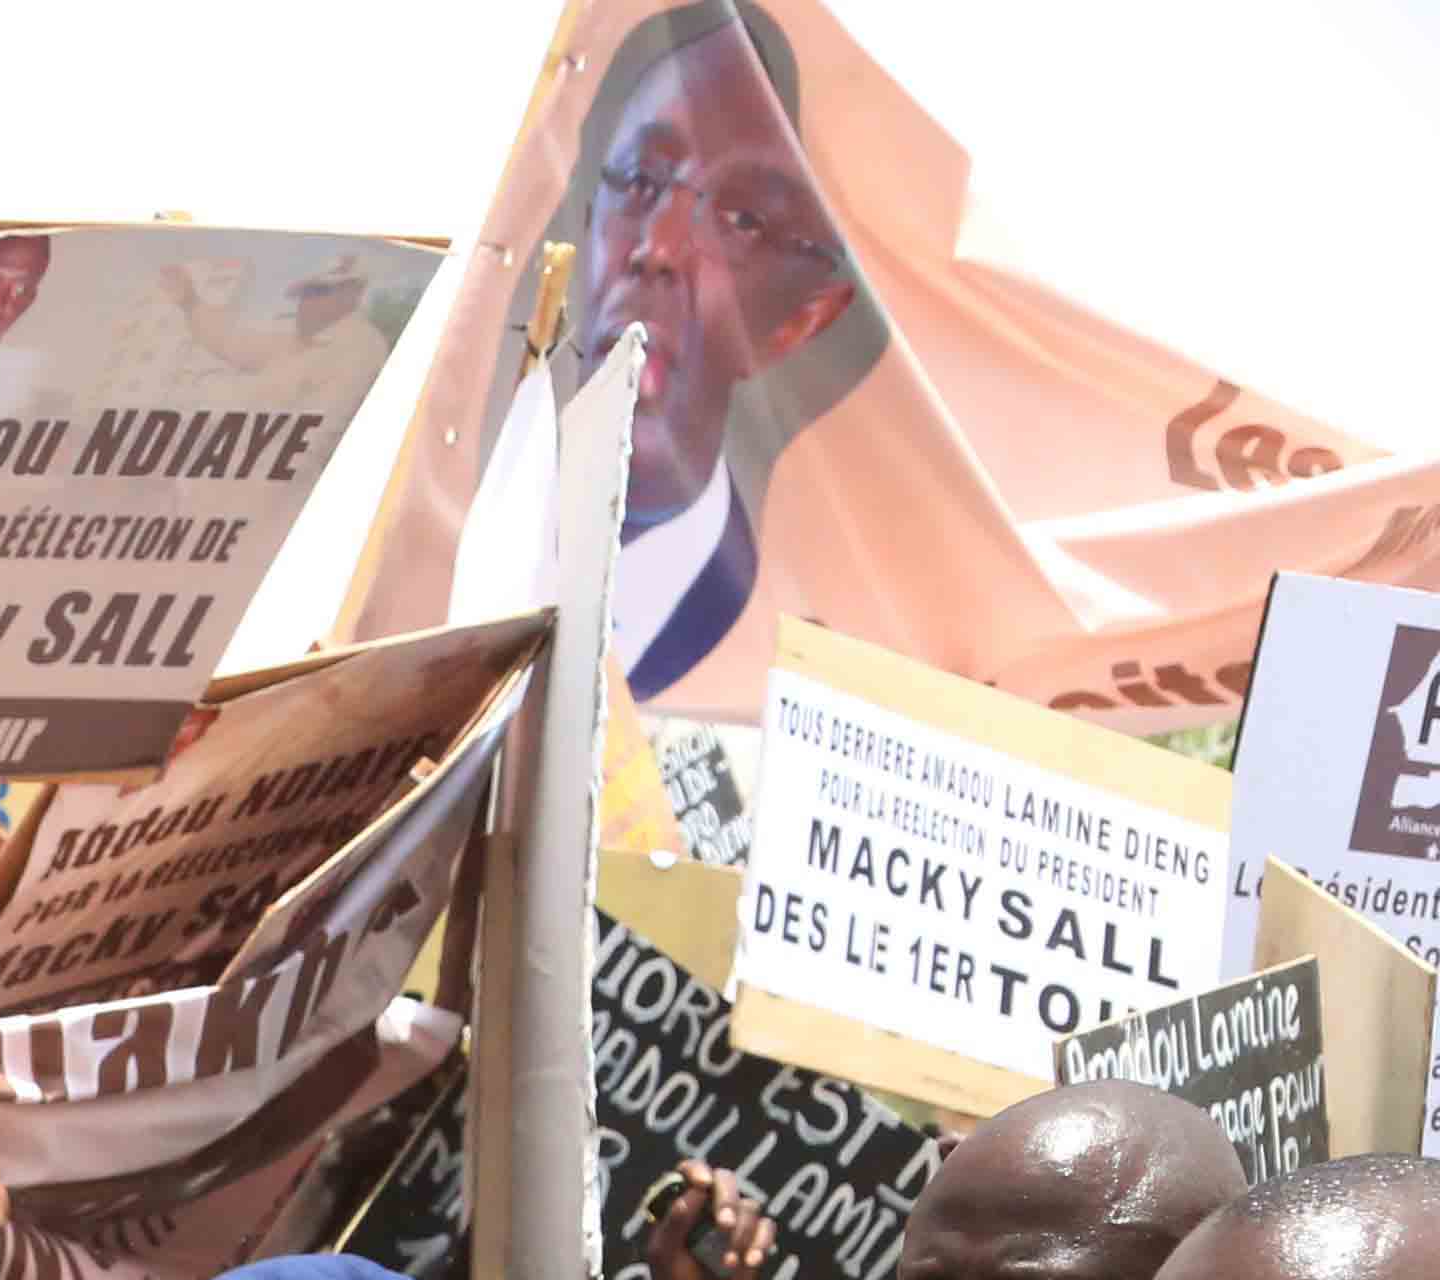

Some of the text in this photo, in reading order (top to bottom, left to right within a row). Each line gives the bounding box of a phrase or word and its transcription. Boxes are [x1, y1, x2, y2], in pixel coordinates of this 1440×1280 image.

[74, 410, 323, 481] NDIAYE
[189, 519, 247, 563] DE
[28, 592, 214, 668] SALL
[778, 697, 1210, 885] TOUS DERRIERE AMADOU LAMINE DIENG
[818, 767, 862, 814] POUR
[867, 787, 887, 822] LA
[999, 836, 1029, 874] DU
[1038, 849, 1159, 917] PRESIDENT
[754, 883, 828, 953] DES
[845, 913, 892, 976] LE
[908, 935, 975, 1003] 1ER
[806, 818, 1180, 990] MACKY SALL
[1192, 978, 1302, 1075] Lamine
